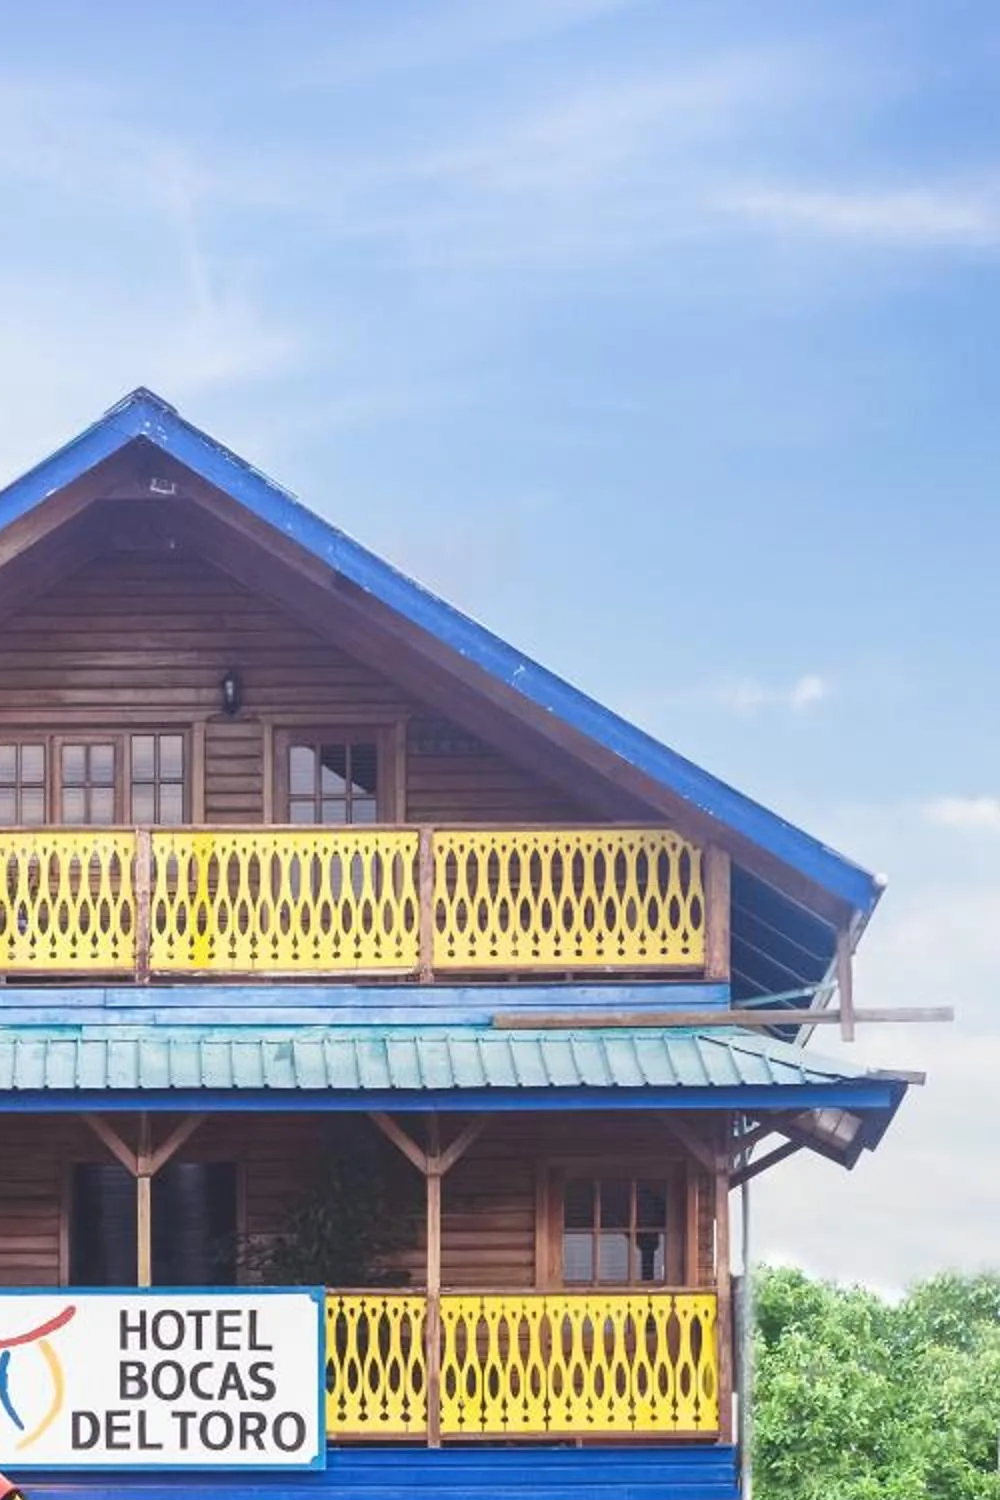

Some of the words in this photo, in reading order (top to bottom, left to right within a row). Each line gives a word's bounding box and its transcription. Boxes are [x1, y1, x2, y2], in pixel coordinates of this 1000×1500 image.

[119, 1309, 273, 1351] HOTEL
[119, 1360, 277, 1401] BOCAS
[71, 1410, 163, 1450] DEL
[171, 1410, 306, 1452] TORO
